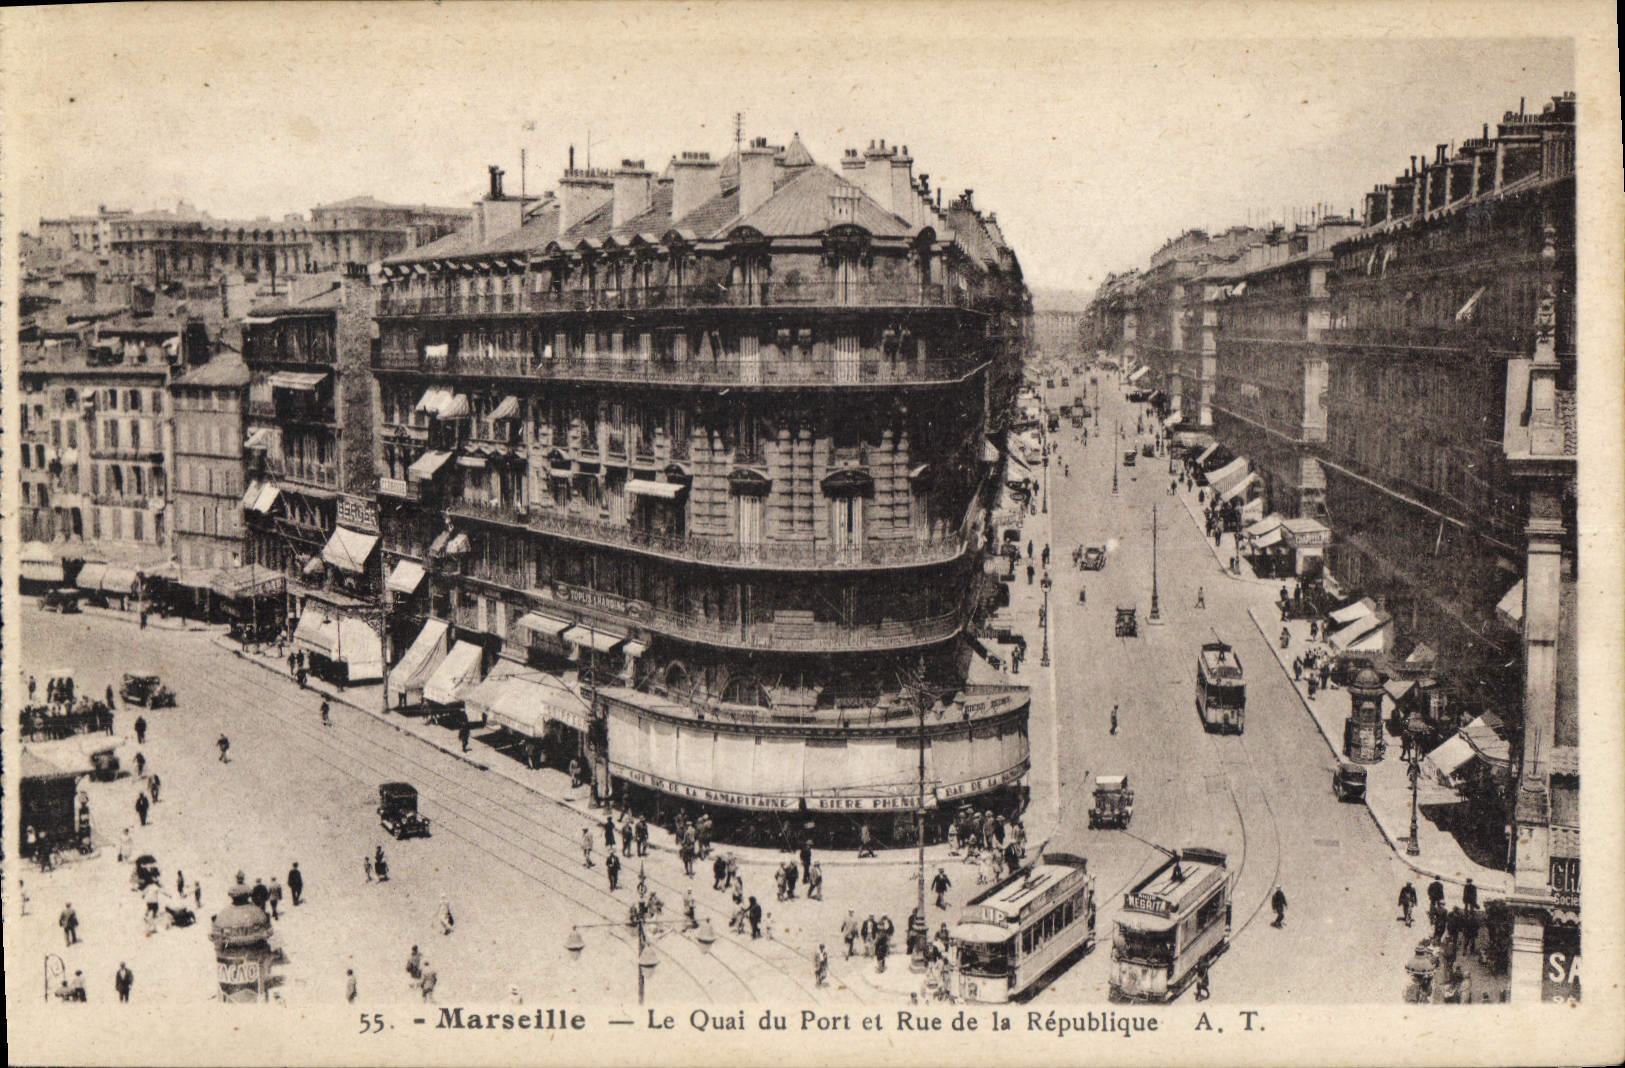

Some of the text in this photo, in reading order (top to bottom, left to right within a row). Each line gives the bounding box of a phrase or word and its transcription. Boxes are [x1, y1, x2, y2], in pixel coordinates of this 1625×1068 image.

[337, 501, 377, 526] BERGER
[945, 784, 965, 798] BAR
[971, 780, 984, 792] DE
[705, 791, 788, 808] SAMARITAINE
[819, 799, 863, 809] BIERE
[1128, 895, 1167, 912] NEGRITA
